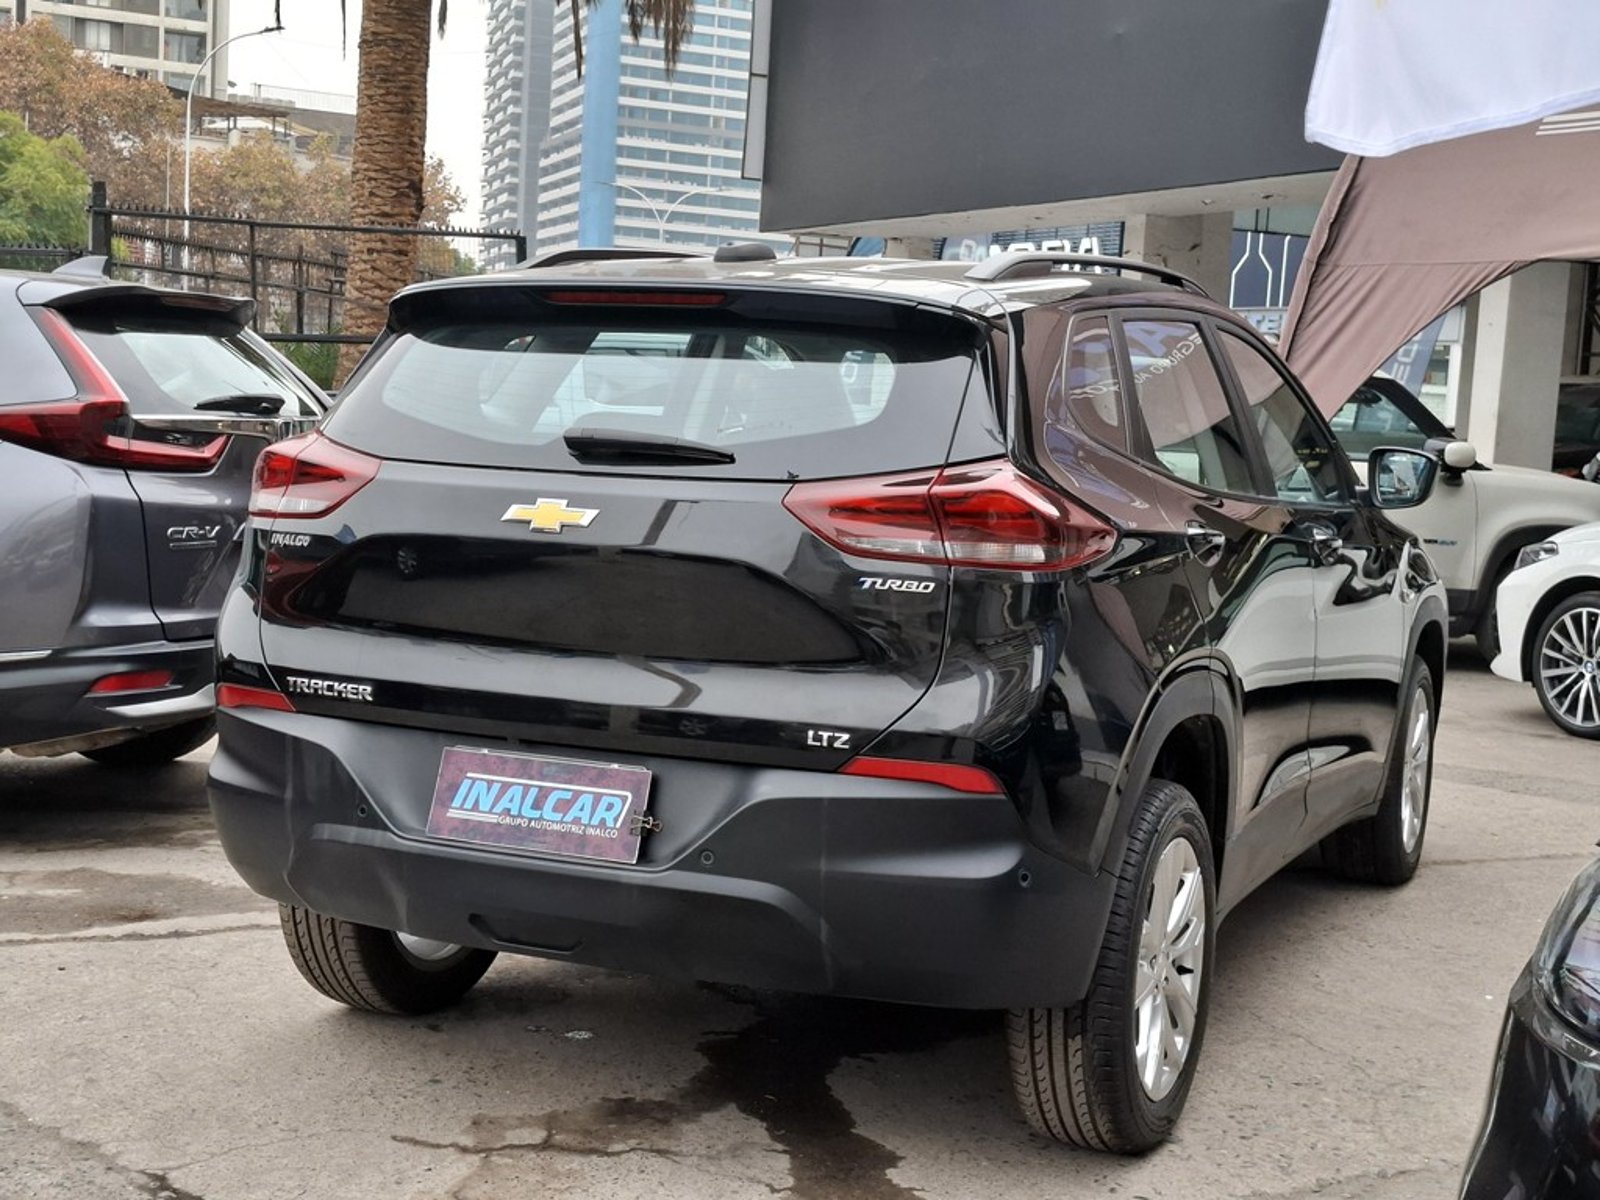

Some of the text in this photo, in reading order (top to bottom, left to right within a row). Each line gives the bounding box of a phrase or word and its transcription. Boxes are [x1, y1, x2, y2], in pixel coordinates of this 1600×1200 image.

[166, 525, 221, 539] CR-V
[858, 576, 936, 594] TURBO
[286, 675, 374, 701] TRACKER
[806, 729, 851, 749] LTZ
[450, 778, 626, 829] INALCAR
[498, 815, 618, 839] GRUPO AUTOMOTRIZ INALCO
